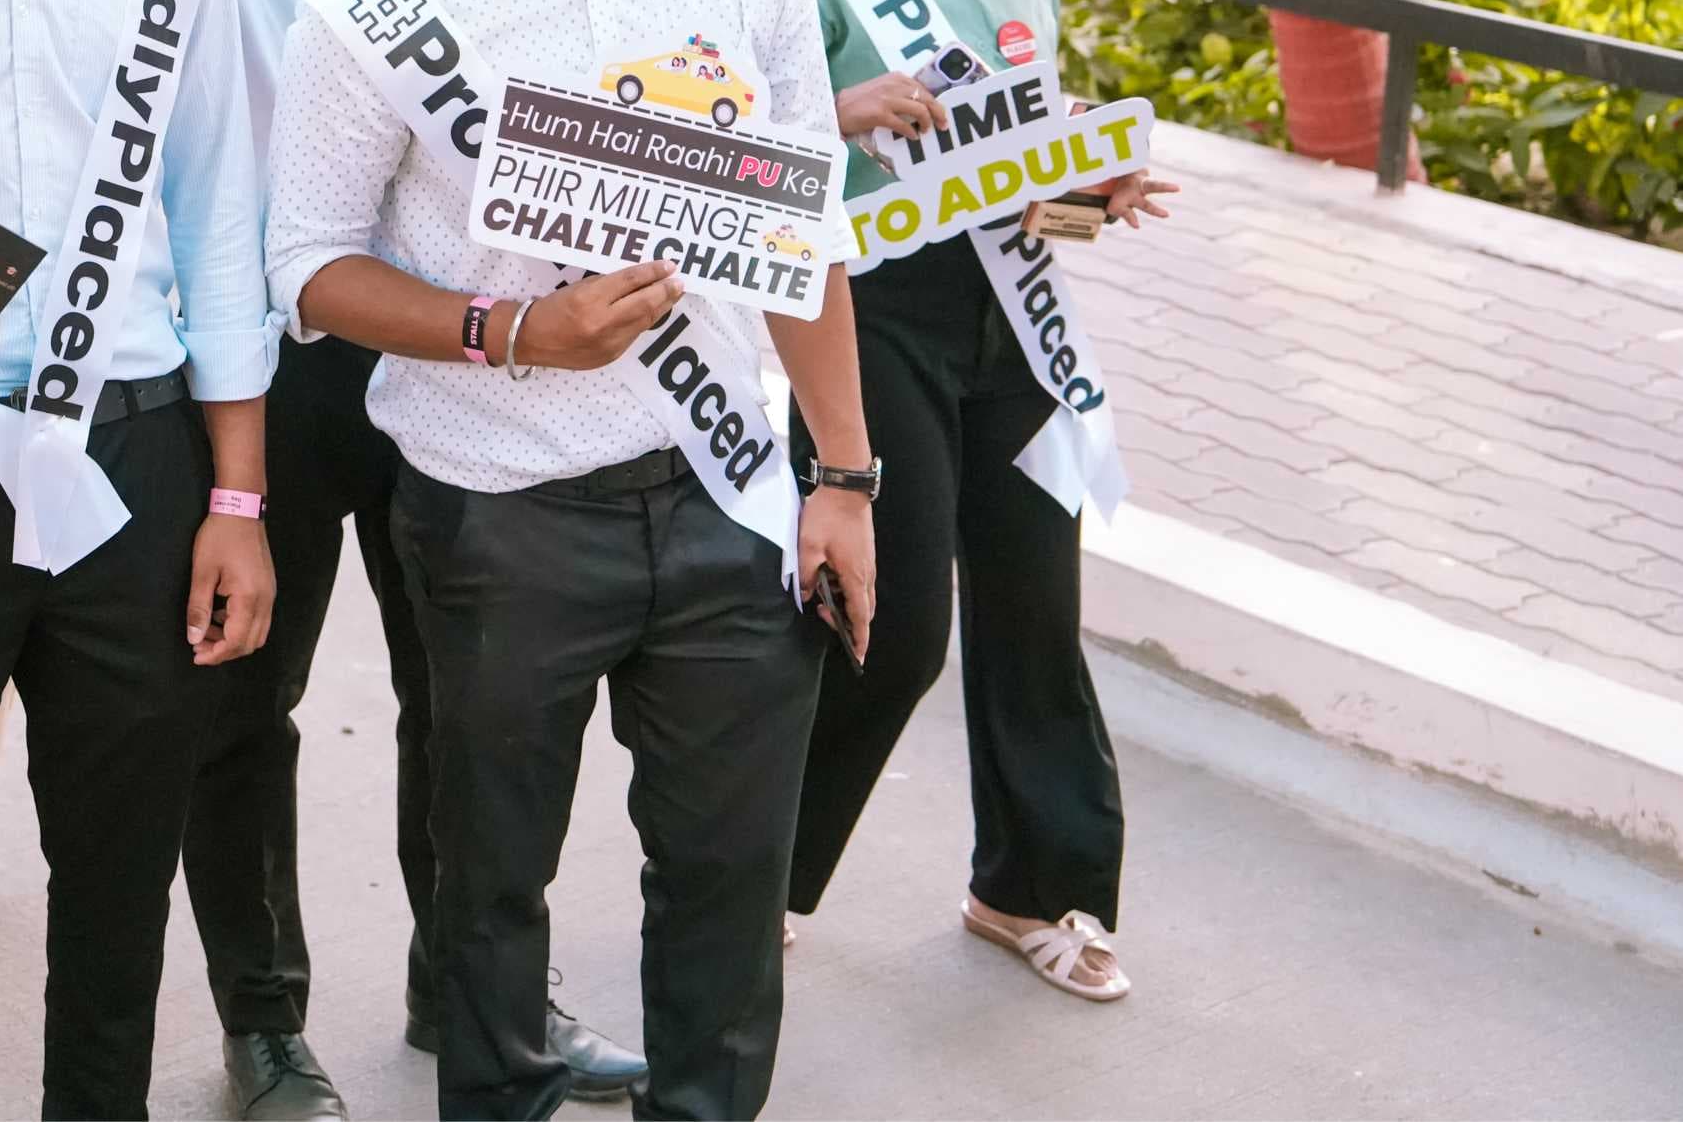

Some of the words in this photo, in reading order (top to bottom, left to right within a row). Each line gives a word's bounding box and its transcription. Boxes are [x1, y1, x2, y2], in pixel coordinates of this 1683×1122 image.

[508, 101, 583, 142] Hum
[588, 120, 642, 155] Hai
[645, 135, 736, 178] Raahi
[736, 155, 783, 188] PU
[782, 167, 820, 198] Ke
[891, 77, 1049, 166] TIME
[488, 155, 582, 207] PHIR
[588, 178, 764, 249] MILENGE
[849, 198, 922, 257] TO
[937, 115, 1139, 227] ADULT
[483, 197, 650, 262] CHALTE
[653, 236, 815, 302] CHALTE
[638, 307, 775, 494] laced
